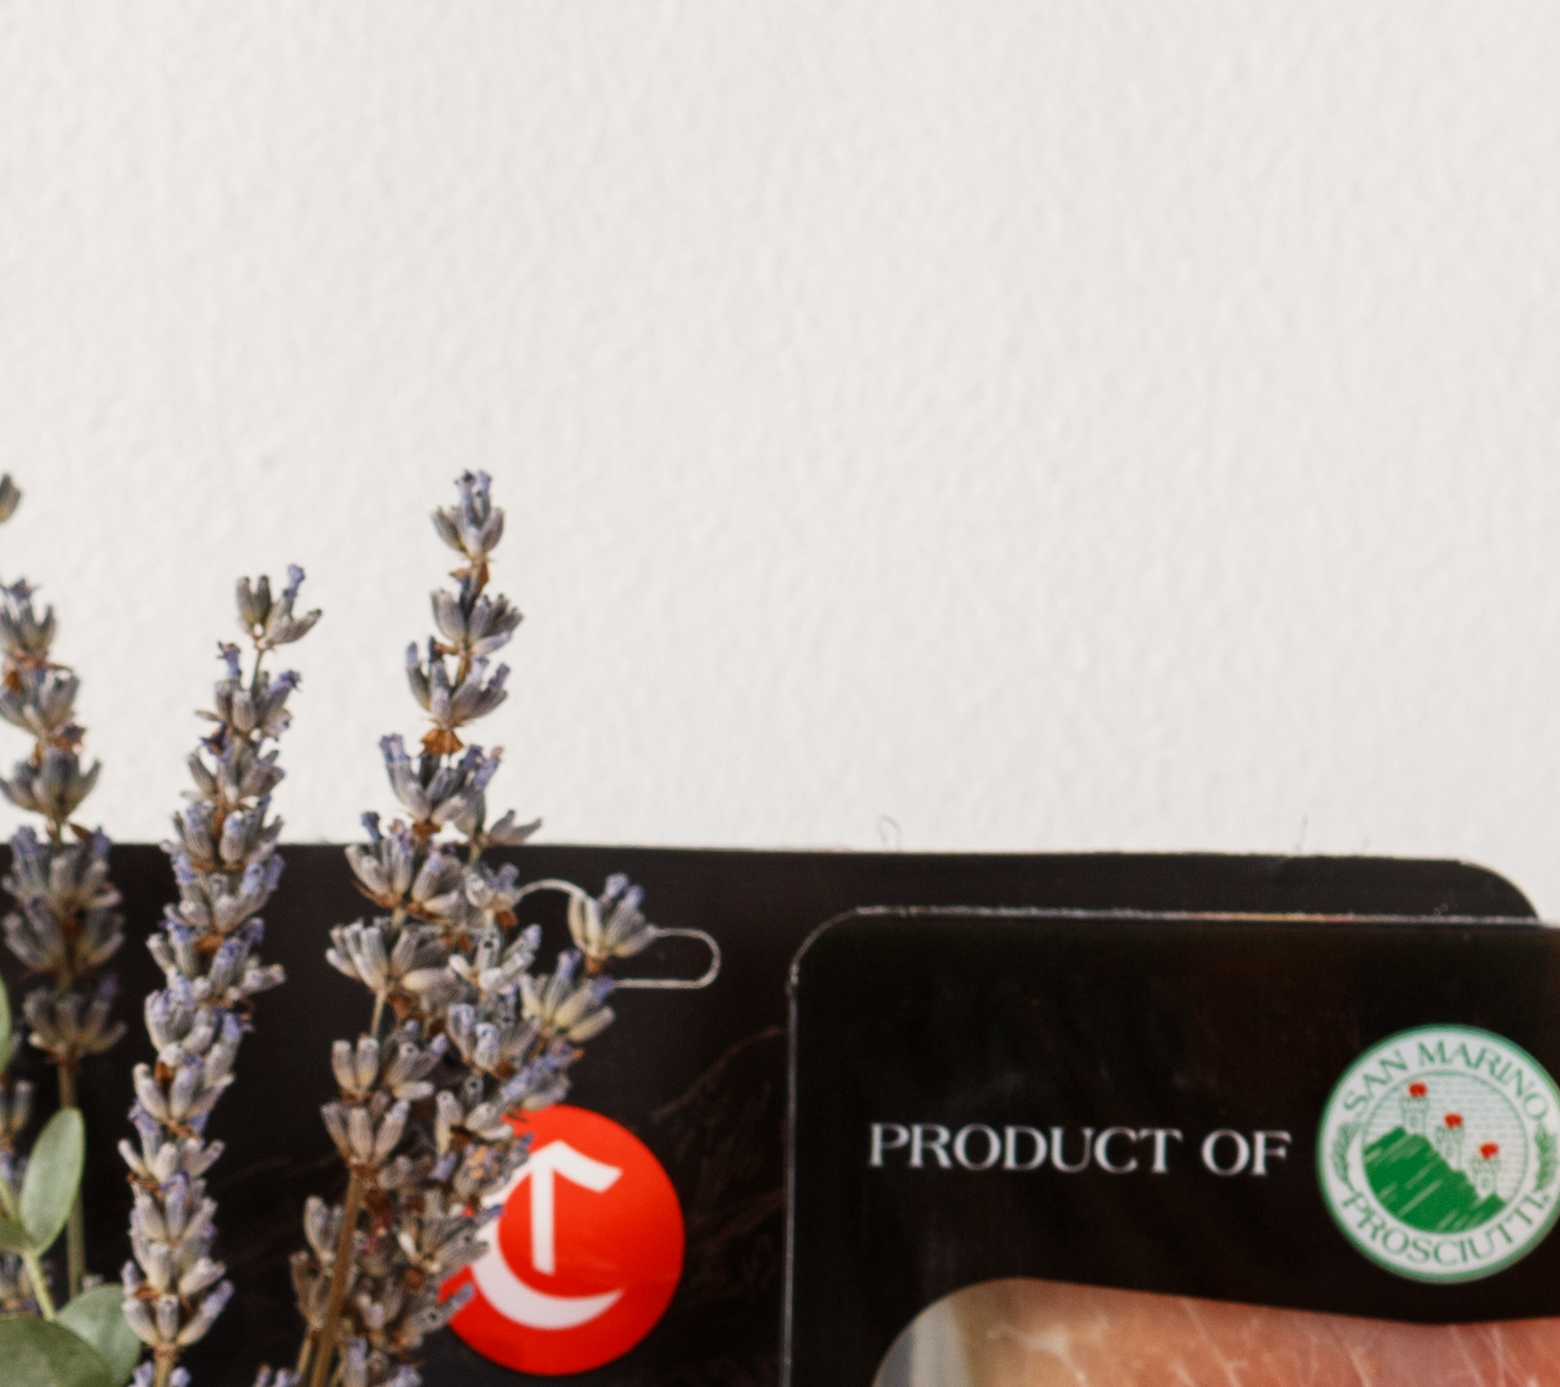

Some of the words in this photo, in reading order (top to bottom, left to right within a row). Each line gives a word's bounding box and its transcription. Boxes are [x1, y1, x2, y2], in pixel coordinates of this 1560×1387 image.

[1343, 1050, 1409, 1111] SAN
[1417, 1039, 1550, 1121] MARINO
[869, 1120, 1184, 1174] PRODUCT
[1200, 1130, 1292, 1176] OF
